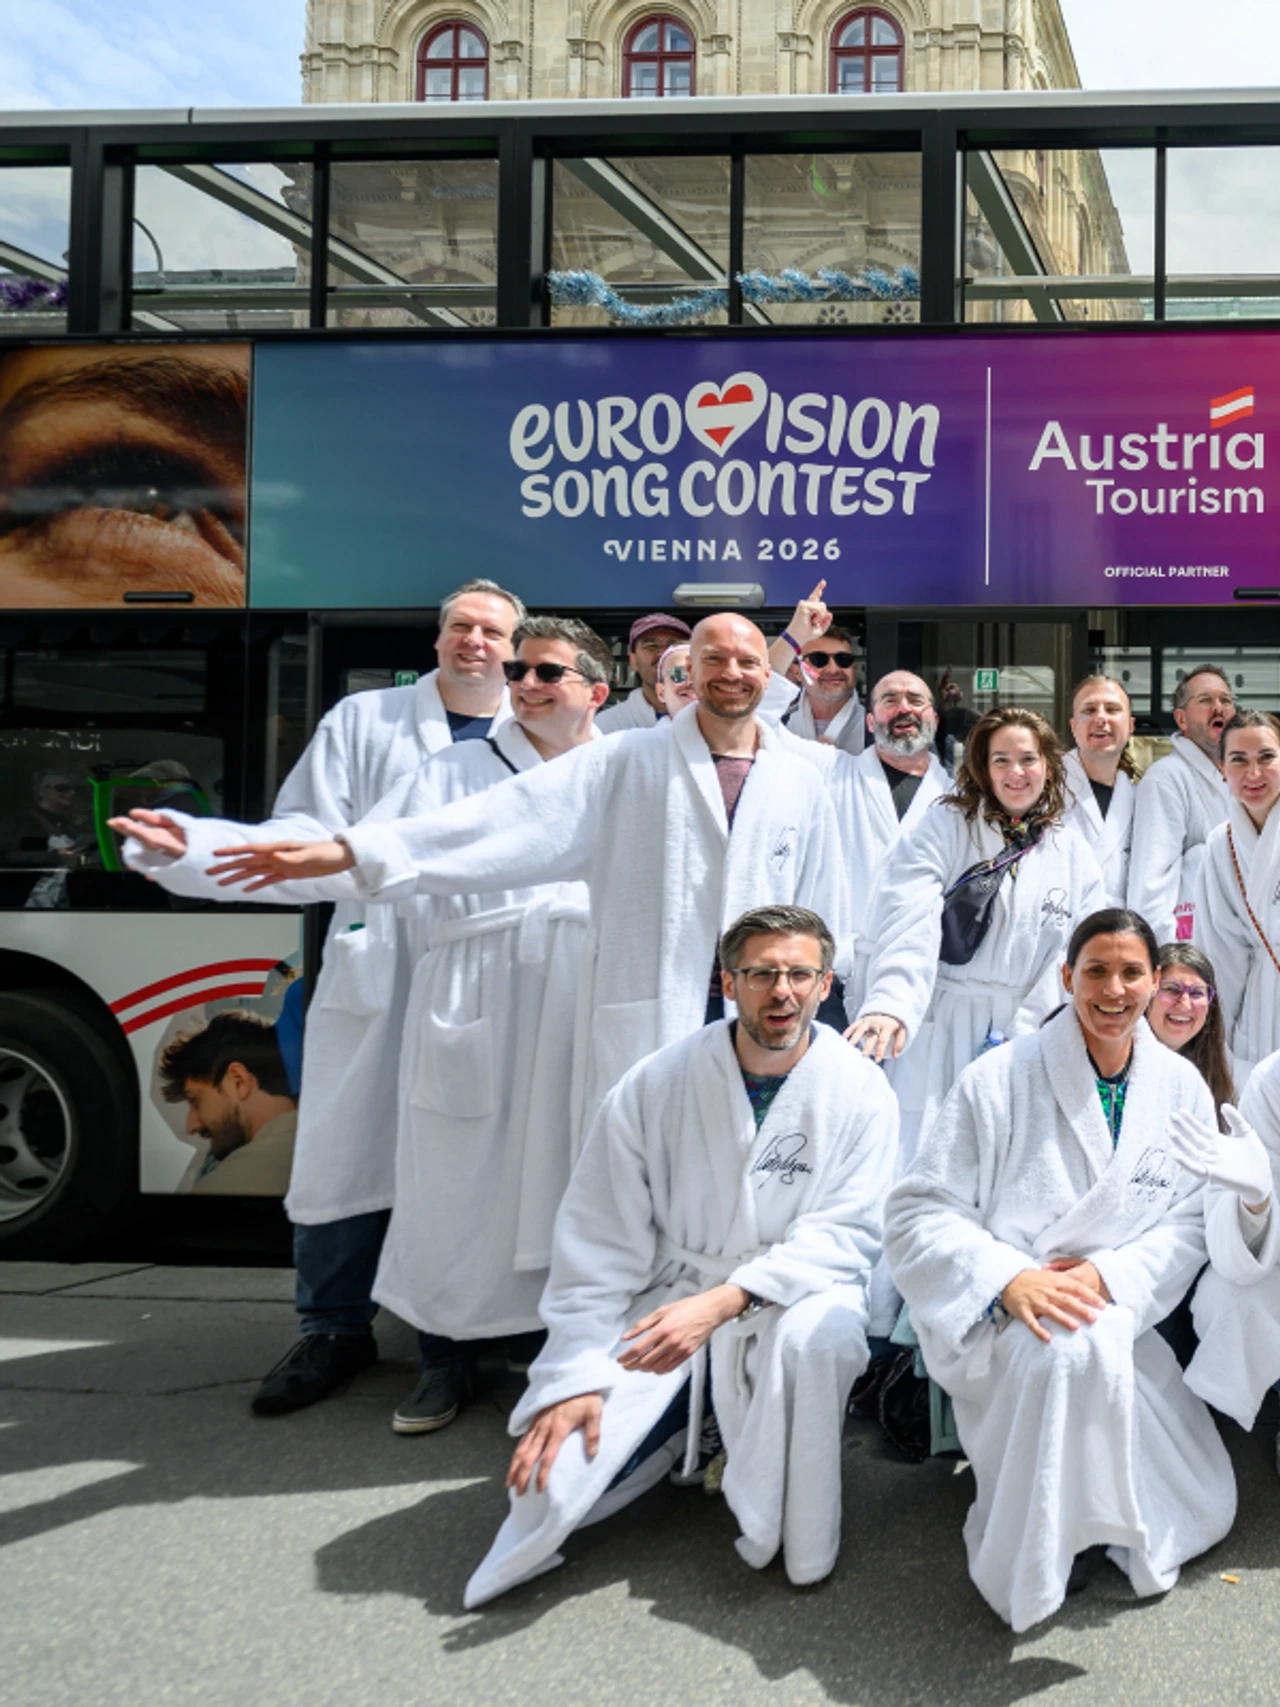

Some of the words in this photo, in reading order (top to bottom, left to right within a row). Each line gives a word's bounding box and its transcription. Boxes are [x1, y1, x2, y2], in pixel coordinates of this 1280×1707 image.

[1028, 420, 1265, 471] Austria
[1085, 476, 1265, 515] Tourism
[604, 539, 743, 562] VIENNA
[757, 537, 842, 561] 2026
[1104, 566, 1165, 578] OFFICIAL
[1169, 566, 1230, 578] PARTNER
